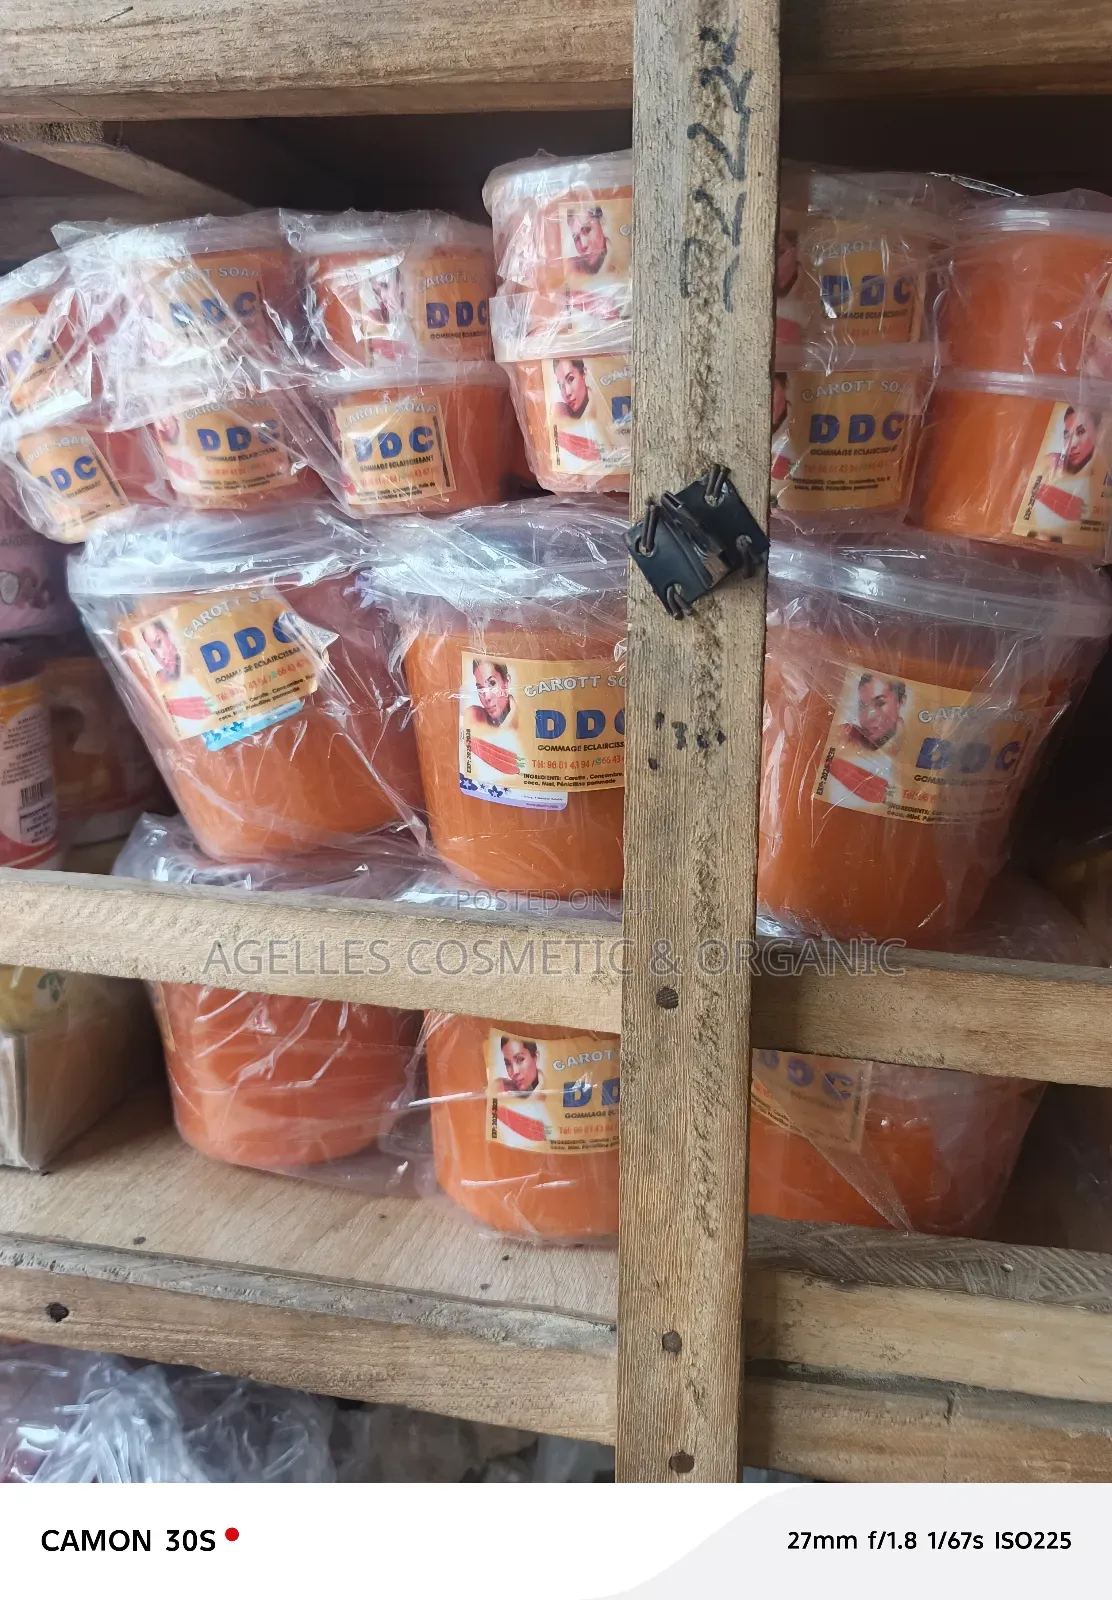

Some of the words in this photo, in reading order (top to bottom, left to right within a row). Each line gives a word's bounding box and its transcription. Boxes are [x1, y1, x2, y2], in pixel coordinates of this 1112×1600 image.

[821, 274, 912, 307] DDC
[800, 380, 875, 402] CAROTT
[196, 419, 281, 452] DDC
[808, 411, 906, 444] DDC
[183, 597, 240, 639] CAROTT
[524, 675, 602, 698] CAROTT
[537, 744, 582, 753] GOMMAGE
[915, 737, 1021, 774] DDC
[586, 778, 616, 787] pommade
[564, 1110, 607, 1119] GOMMAGE
